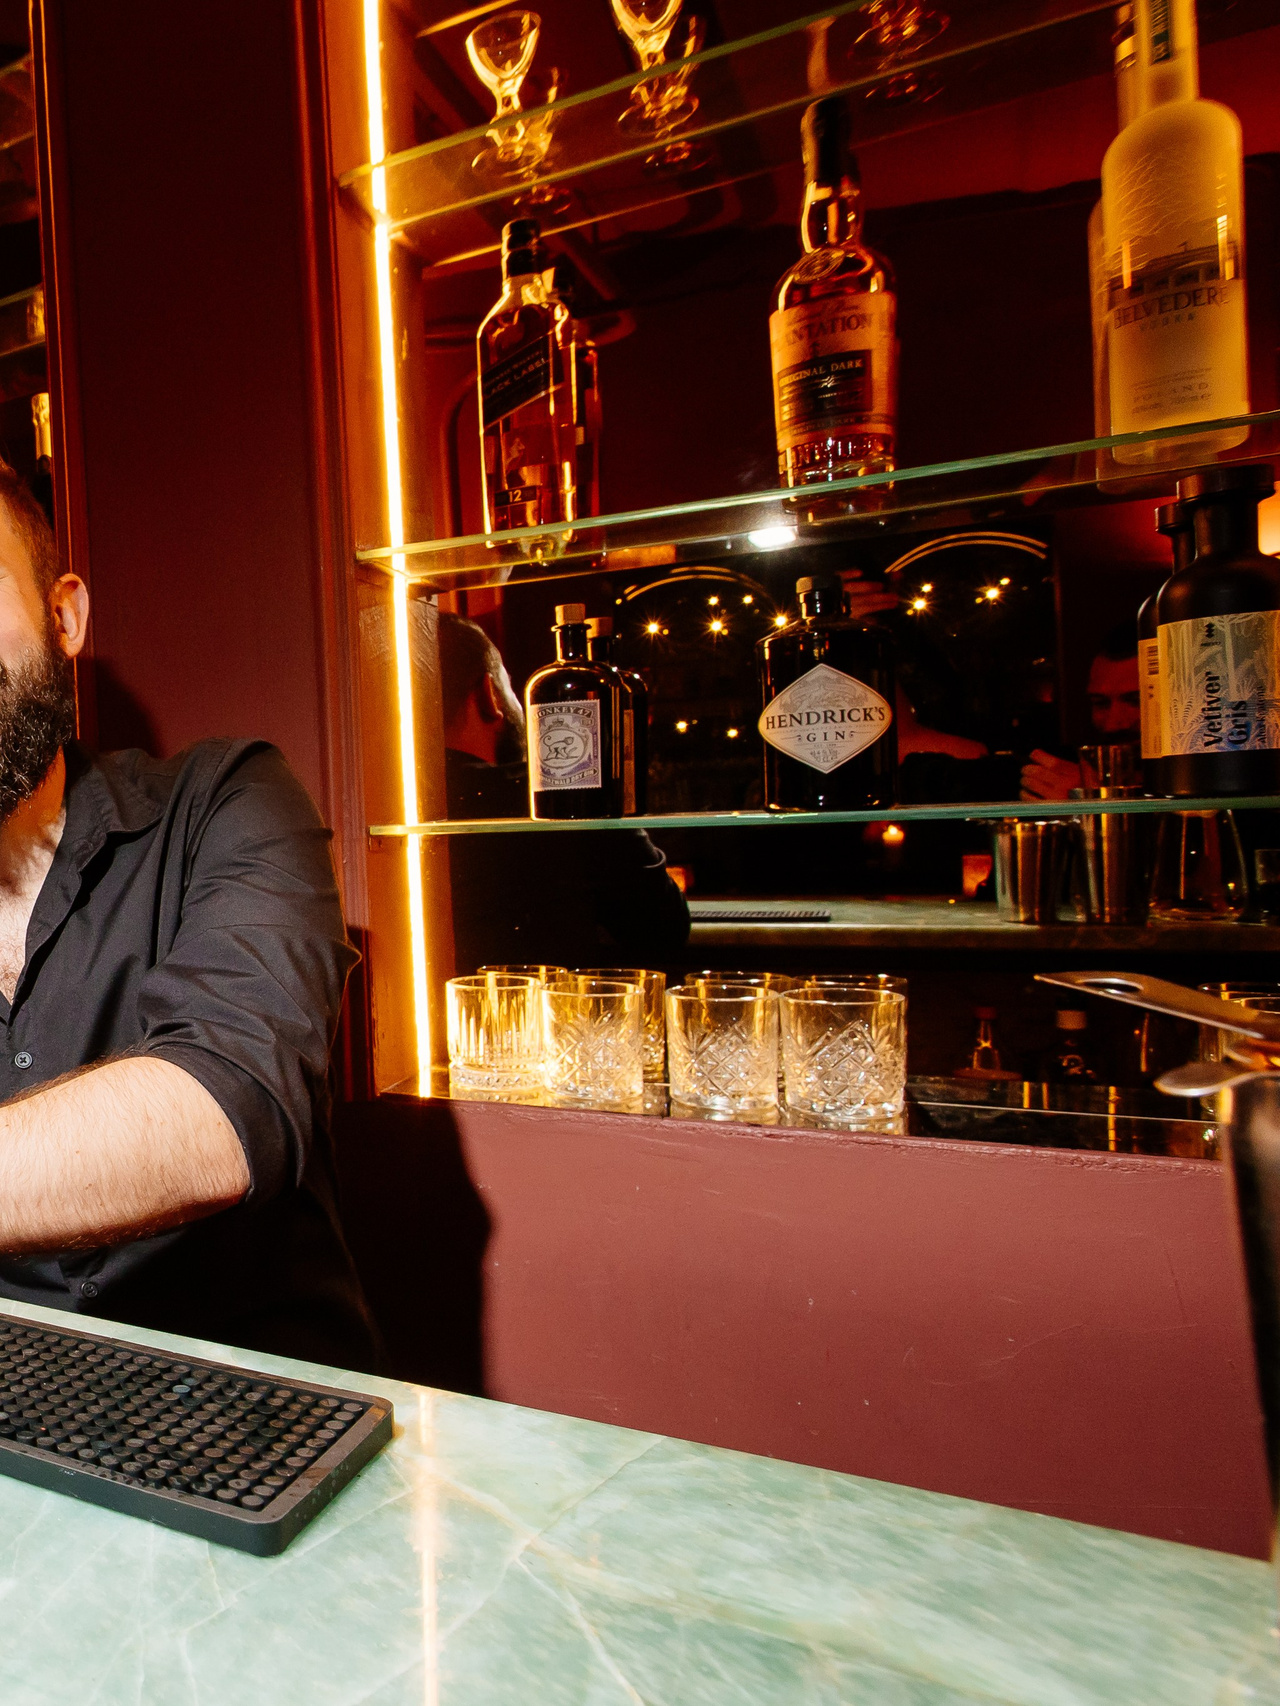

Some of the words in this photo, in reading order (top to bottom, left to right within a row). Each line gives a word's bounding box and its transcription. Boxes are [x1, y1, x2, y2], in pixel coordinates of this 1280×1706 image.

[1114, 285, 1230, 329] BELVEDERE
[783, 312, 873, 347] ANTATION
[830, 359, 863, 372] DARK
[508, 489, 522, 503] 12
[577, 707, 591, 717] 47
[766, 706, 885, 730] HENDRICK'S
[1201, 671, 1223, 747] Vetiver
[1225, 700, 1248, 745] Gris
[806, 731, 846, 743] GIN
